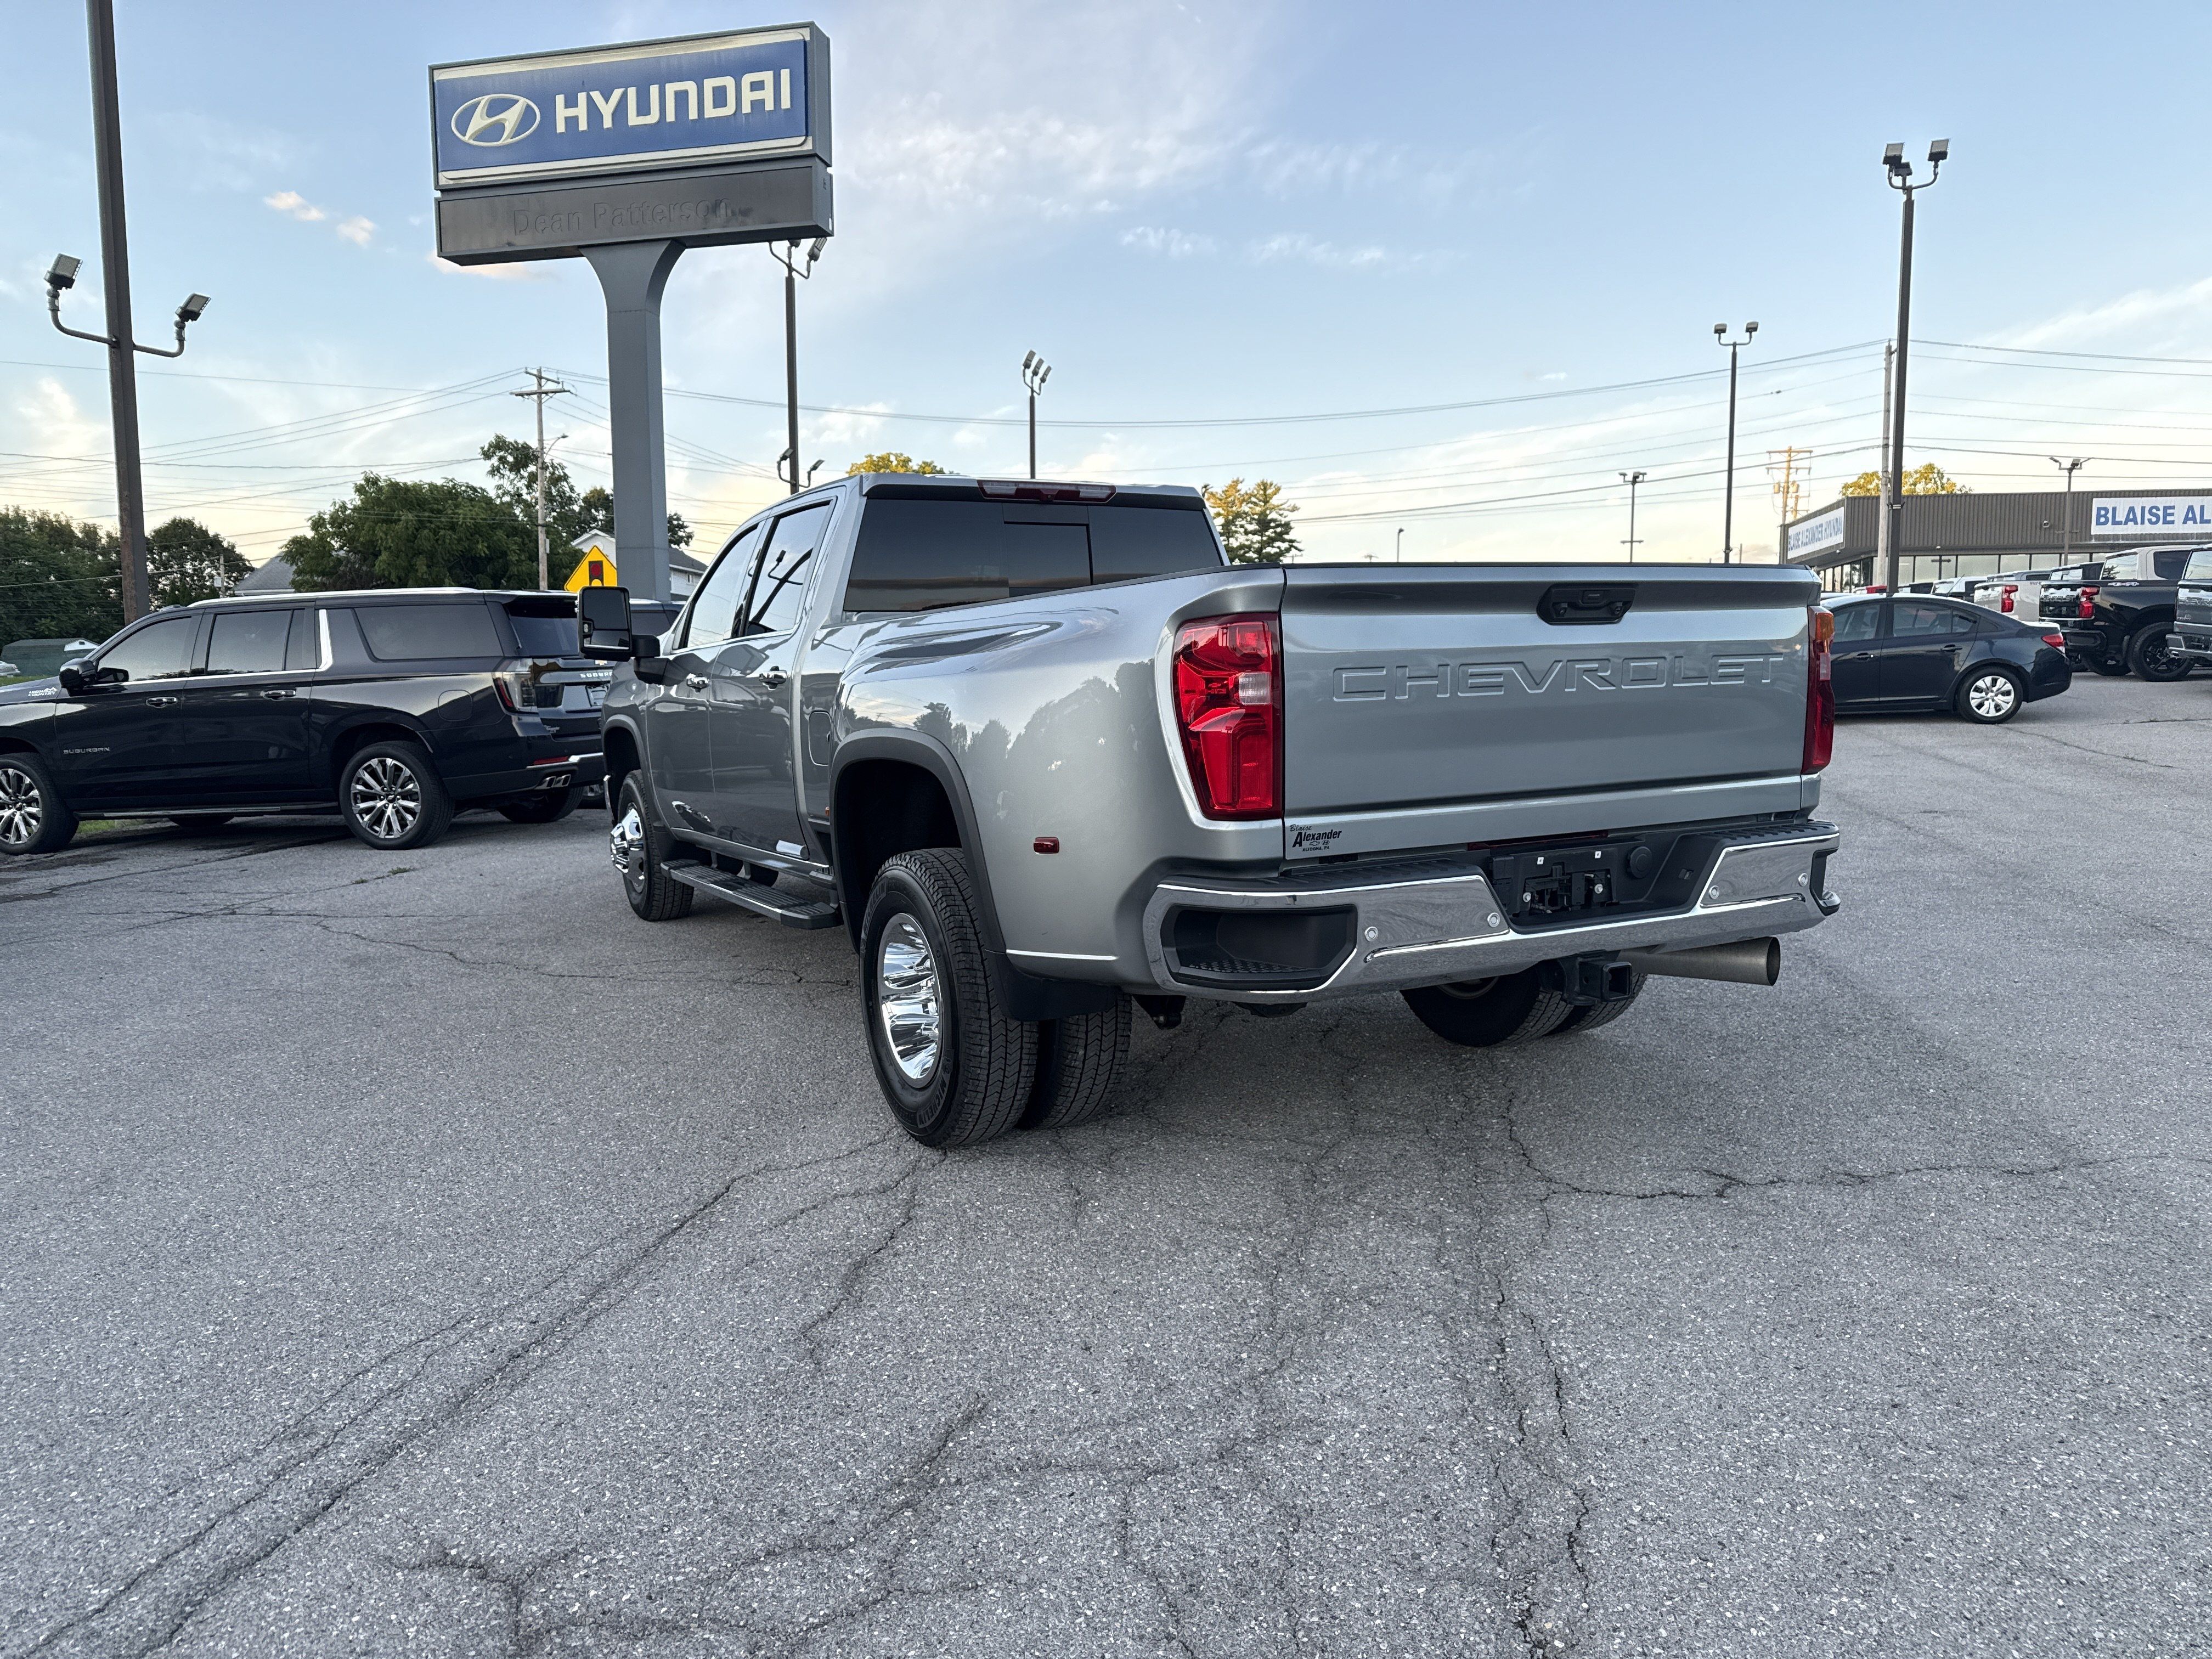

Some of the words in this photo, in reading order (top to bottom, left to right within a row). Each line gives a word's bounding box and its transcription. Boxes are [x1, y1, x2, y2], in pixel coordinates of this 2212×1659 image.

[555, 69, 791, 133] HYUNDAI
[513, 209, 582, 236] Dean
[593, 198, 731, 229] Patterson
[1788, 531, 1801, 551] BLAISE
[1801, 522, 1824, 547] ALEXANDER
[1824, 516, 1843, 540] HYUNDAI
[2095, 505, 2176, 526] BLAISE
[2182, 504, 2212, 525] AL
[1333, 653, 1784, 702] CHEVROLET
[1292, 829, 1342, 848] Alexander
[917, 1074, 947, 1126] MICHELIN
